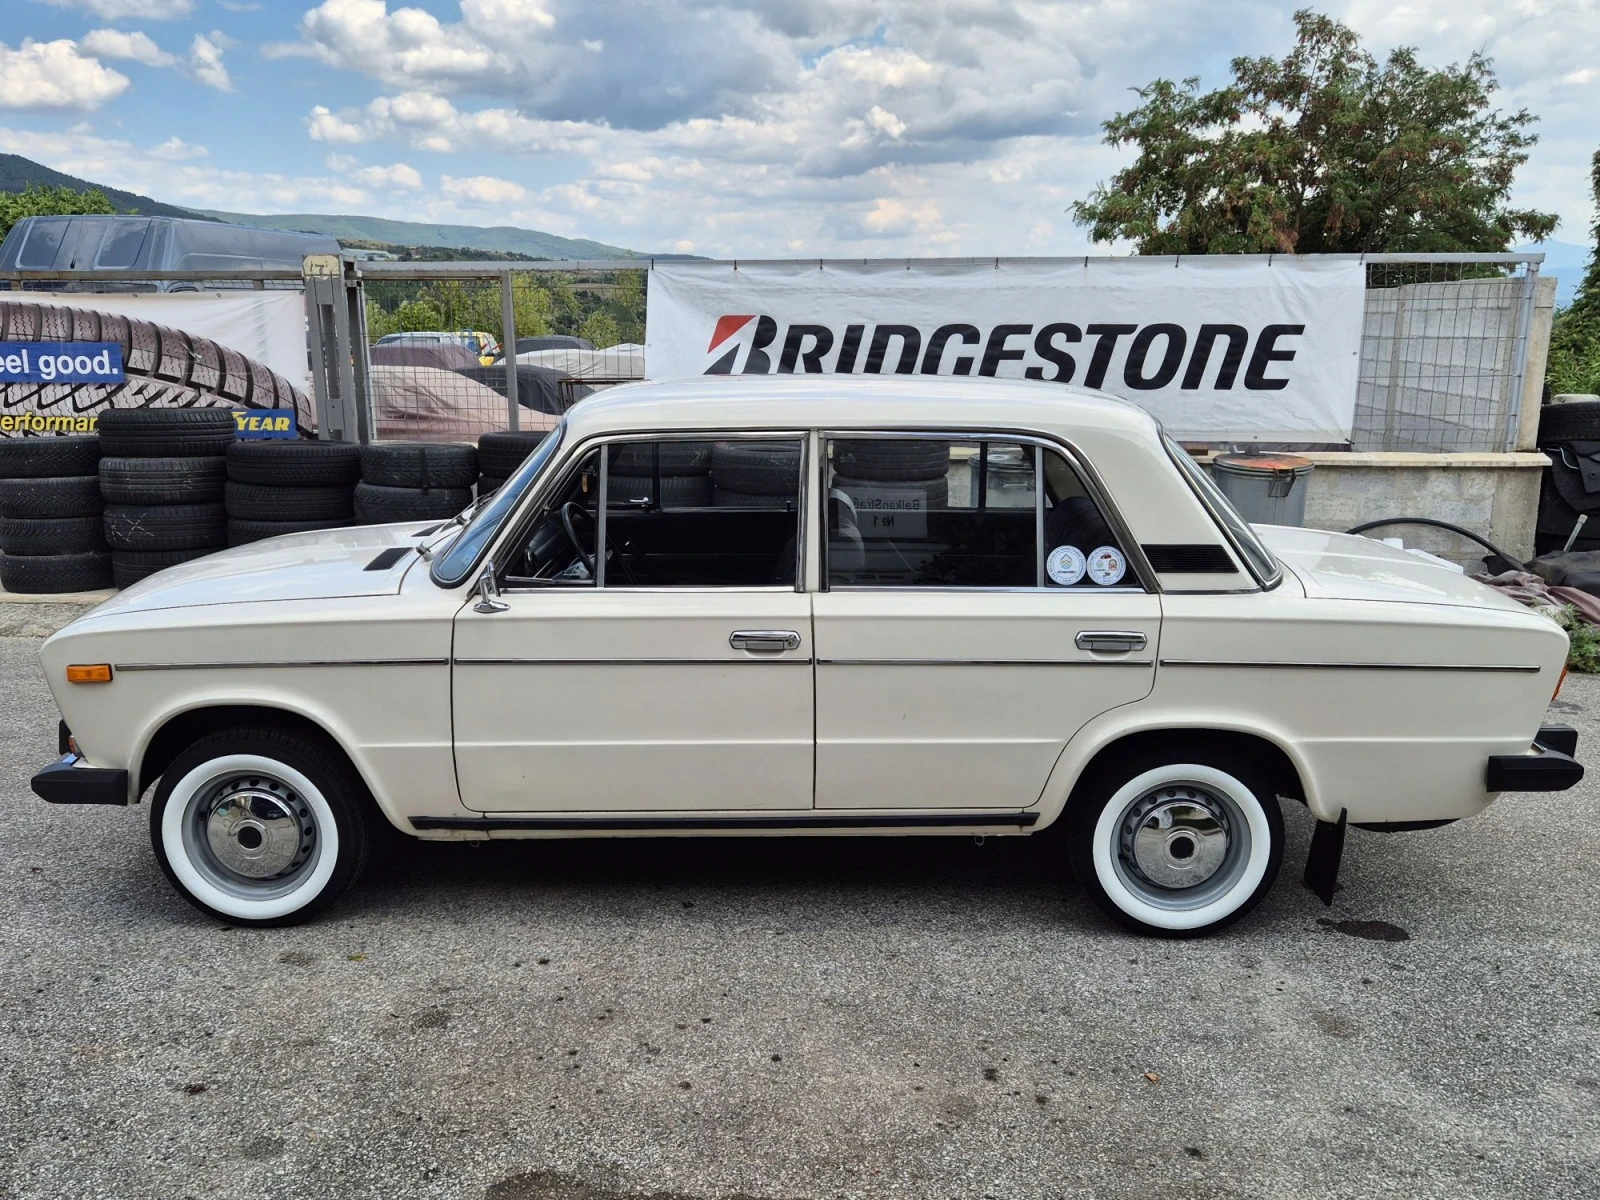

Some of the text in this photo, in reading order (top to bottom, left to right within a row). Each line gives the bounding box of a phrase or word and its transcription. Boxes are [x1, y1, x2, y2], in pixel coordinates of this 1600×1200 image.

[38, 349, 119, 380] good.
[702, 314, 1306, 390] BRIDGESTONE
[234, 415, 290, 431] YEAR
